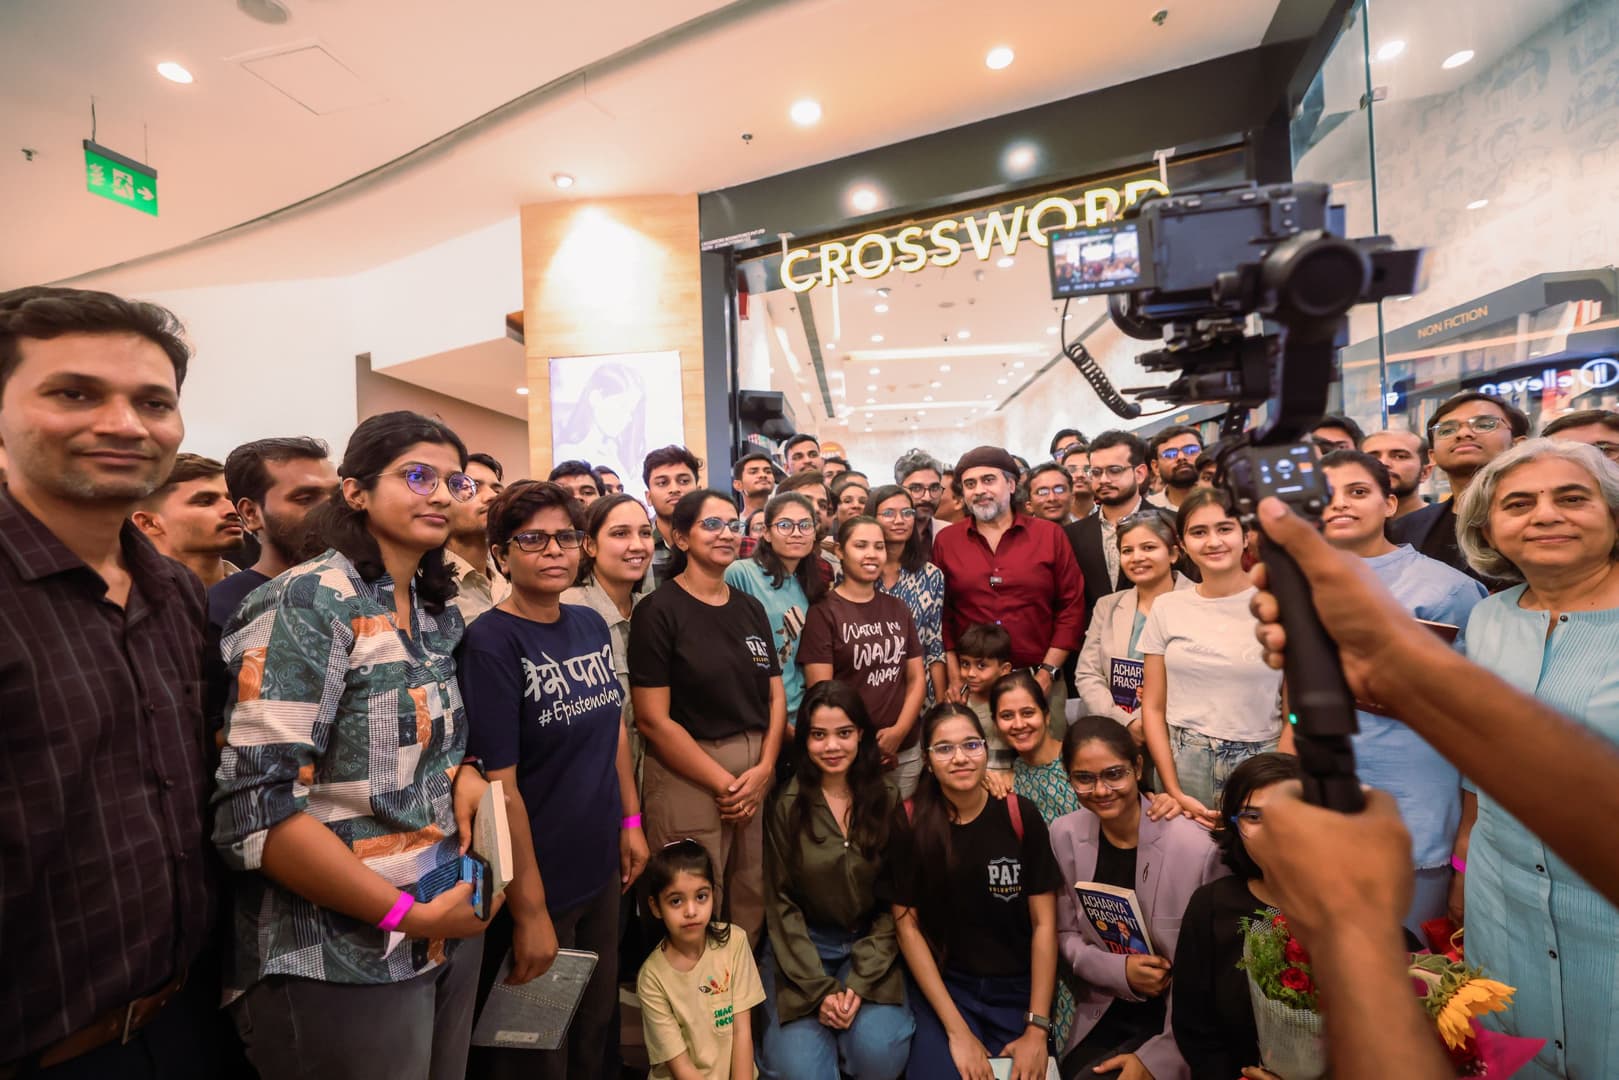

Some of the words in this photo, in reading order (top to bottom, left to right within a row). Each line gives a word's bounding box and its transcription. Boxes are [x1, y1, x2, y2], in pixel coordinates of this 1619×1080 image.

[1418, 322, 1443, 339] NON
[1444, 305, 1489, 330] FICTION
[853, 635, 907, 671] WALK
[867, 667, 901, 687] AWAY
[987, 863, 1021, 885] PAF
[1082, 895, 1128, 916] ACHARYA
